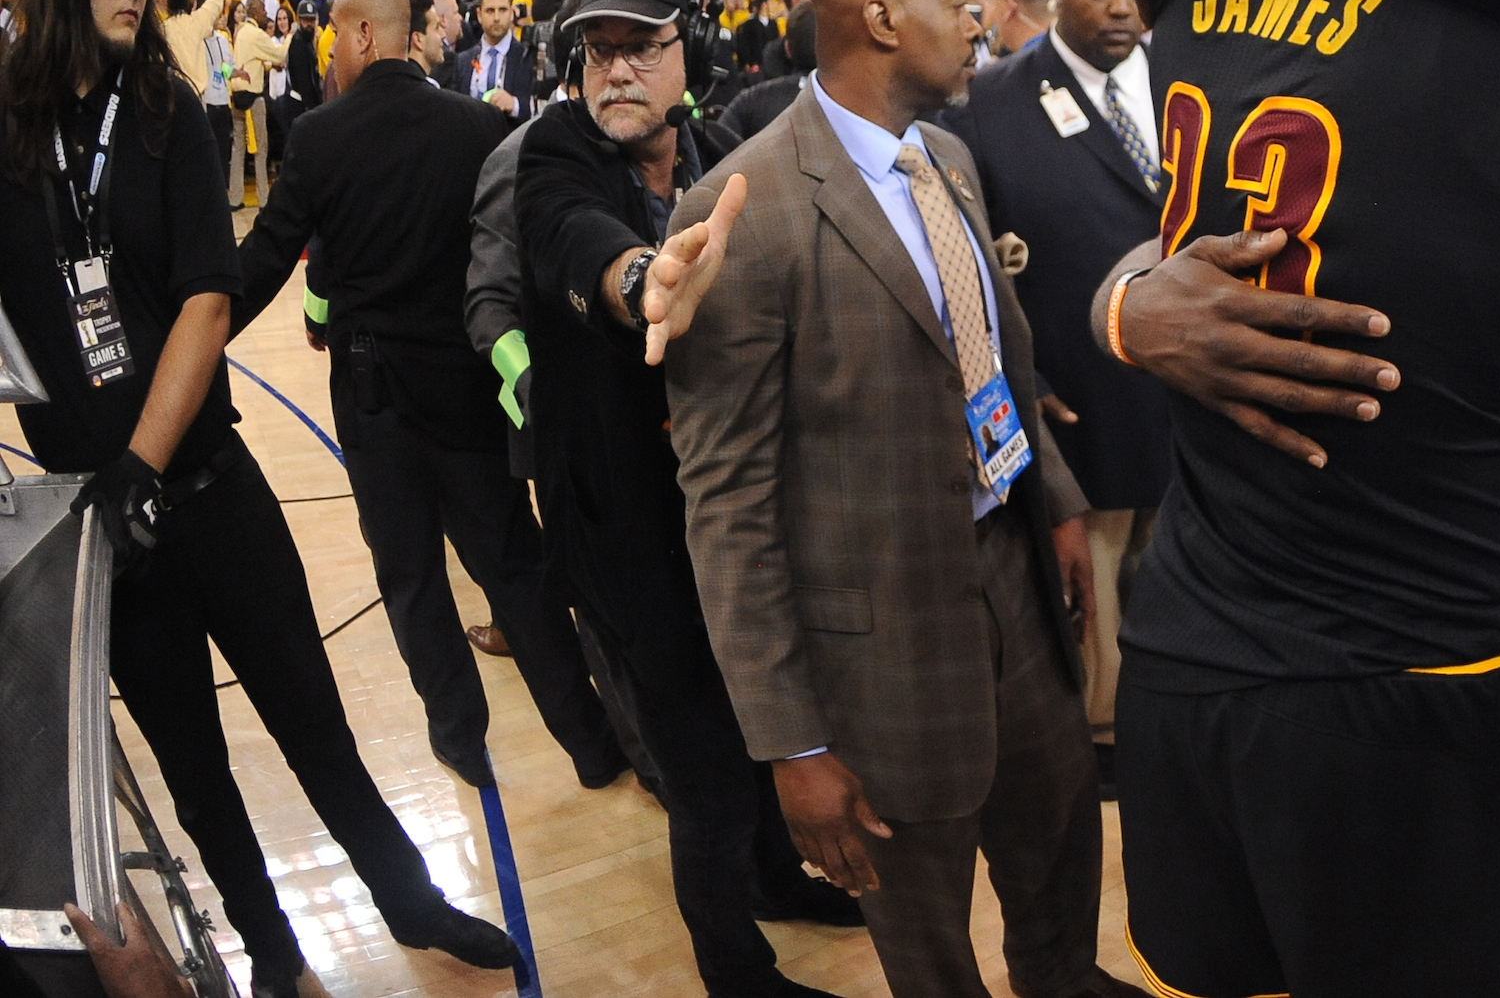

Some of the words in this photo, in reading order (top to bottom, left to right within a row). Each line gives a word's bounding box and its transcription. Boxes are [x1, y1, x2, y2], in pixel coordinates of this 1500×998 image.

[99, 93, 120, 146] RAIDERS
[1161, 80, 1342, 312] 23
[94, 315, 112, 327] TROPHY
[88, 344, 117, 367] GAME
[117, 342, 126, 357] 5
[989, 460, 1003, 475] ALL
[1001, 434, 1025, 463] GAMES
